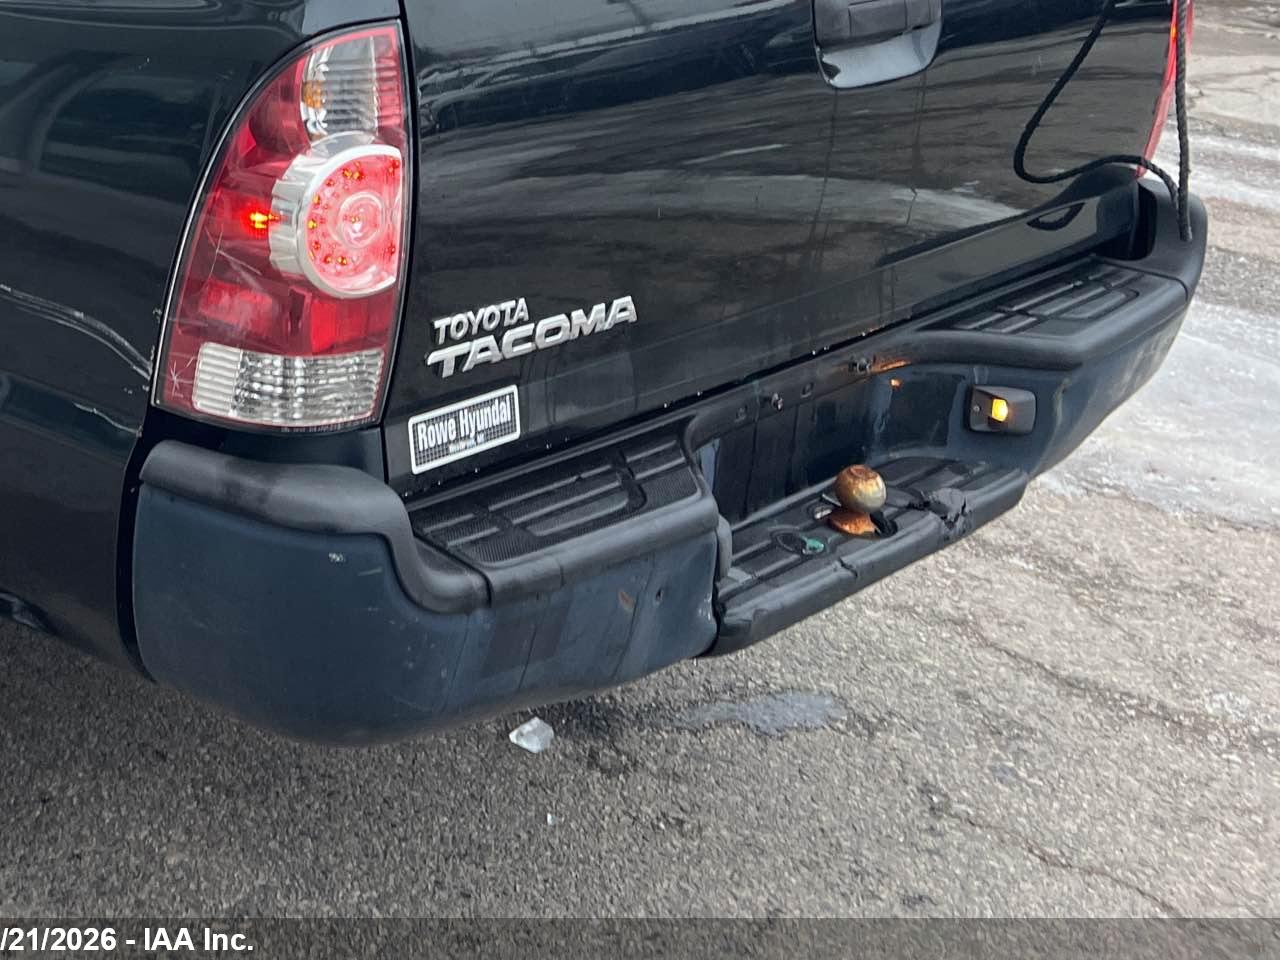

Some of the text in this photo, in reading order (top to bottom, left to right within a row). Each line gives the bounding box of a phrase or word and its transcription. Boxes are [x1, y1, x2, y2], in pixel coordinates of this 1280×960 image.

[425, 295, 638, 379] TACOMA
[432, 297, 530, 345] TOYOTA
[417, 418, 457, 451] Rowe
[459, 394, 512, 438] Hyundai
